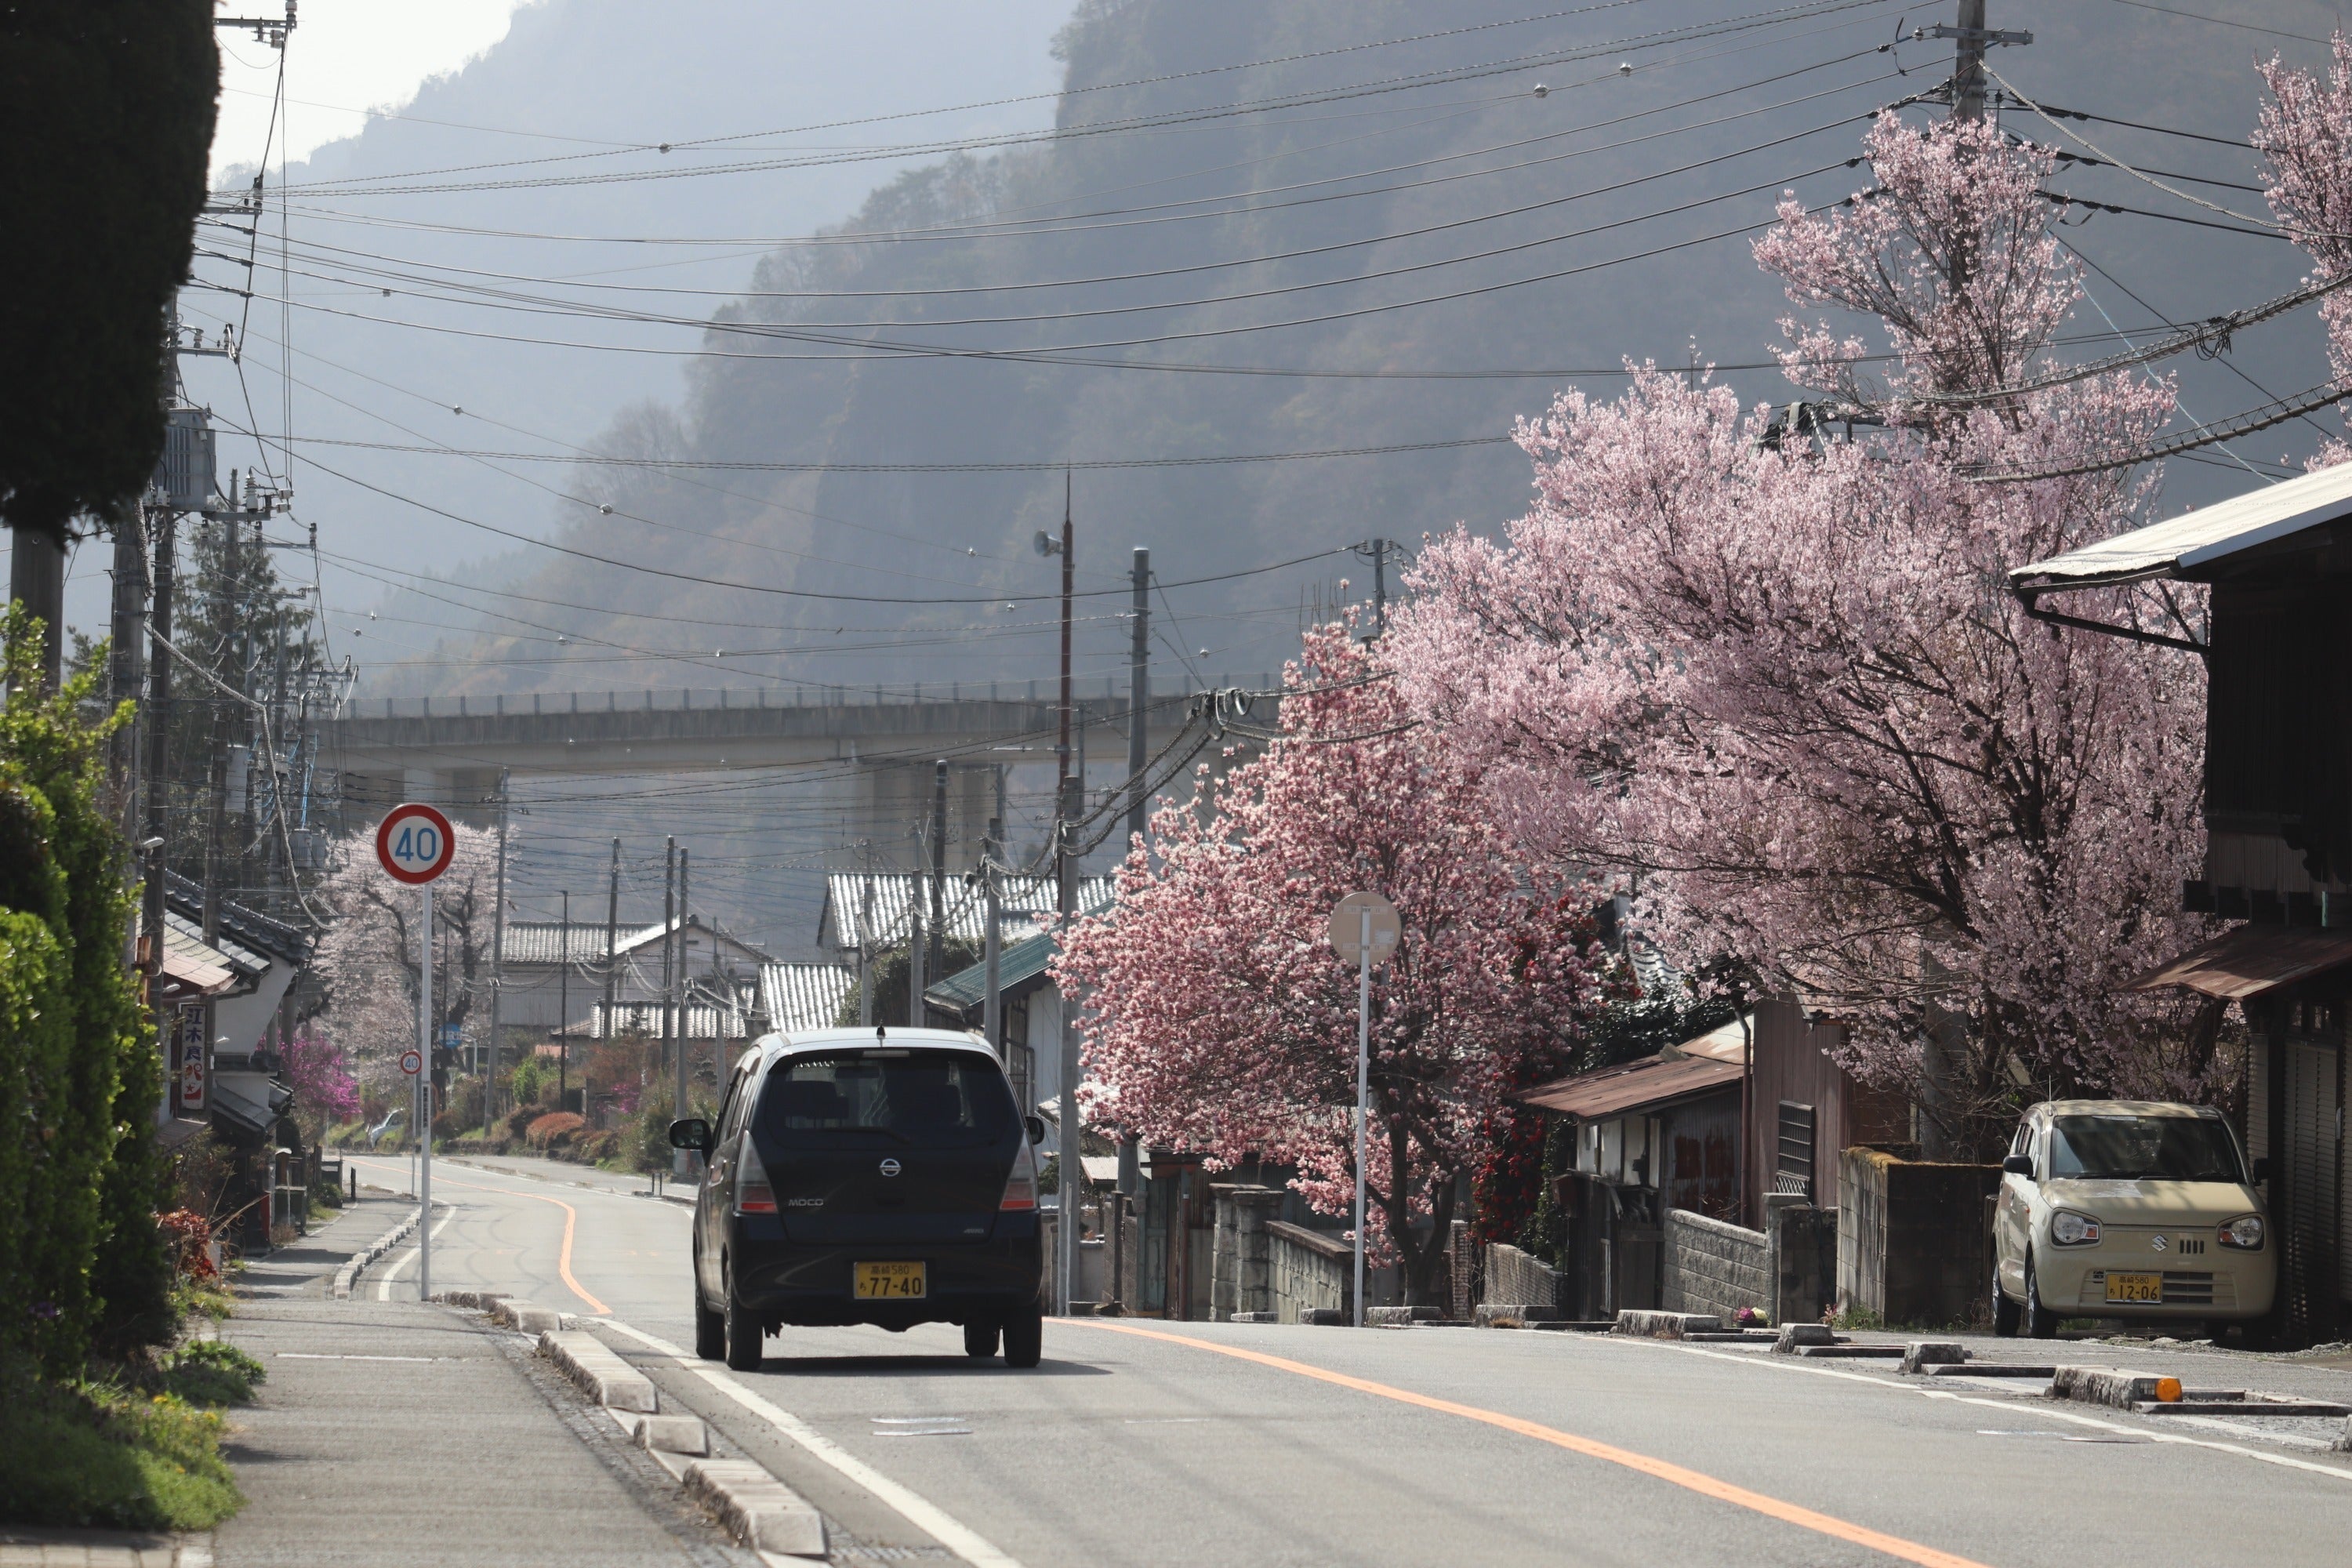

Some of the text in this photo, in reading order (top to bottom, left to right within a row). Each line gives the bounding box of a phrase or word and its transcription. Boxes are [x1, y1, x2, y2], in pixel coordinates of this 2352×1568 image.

[395, 827, 437, 862] 40
[405, 1058, 418, 1069] 40
[891, 1265, 909, 1275] 580
[870, 1277, 921, 1295] 77-40
[2120, 1285, 2158, 1299] 12-06
